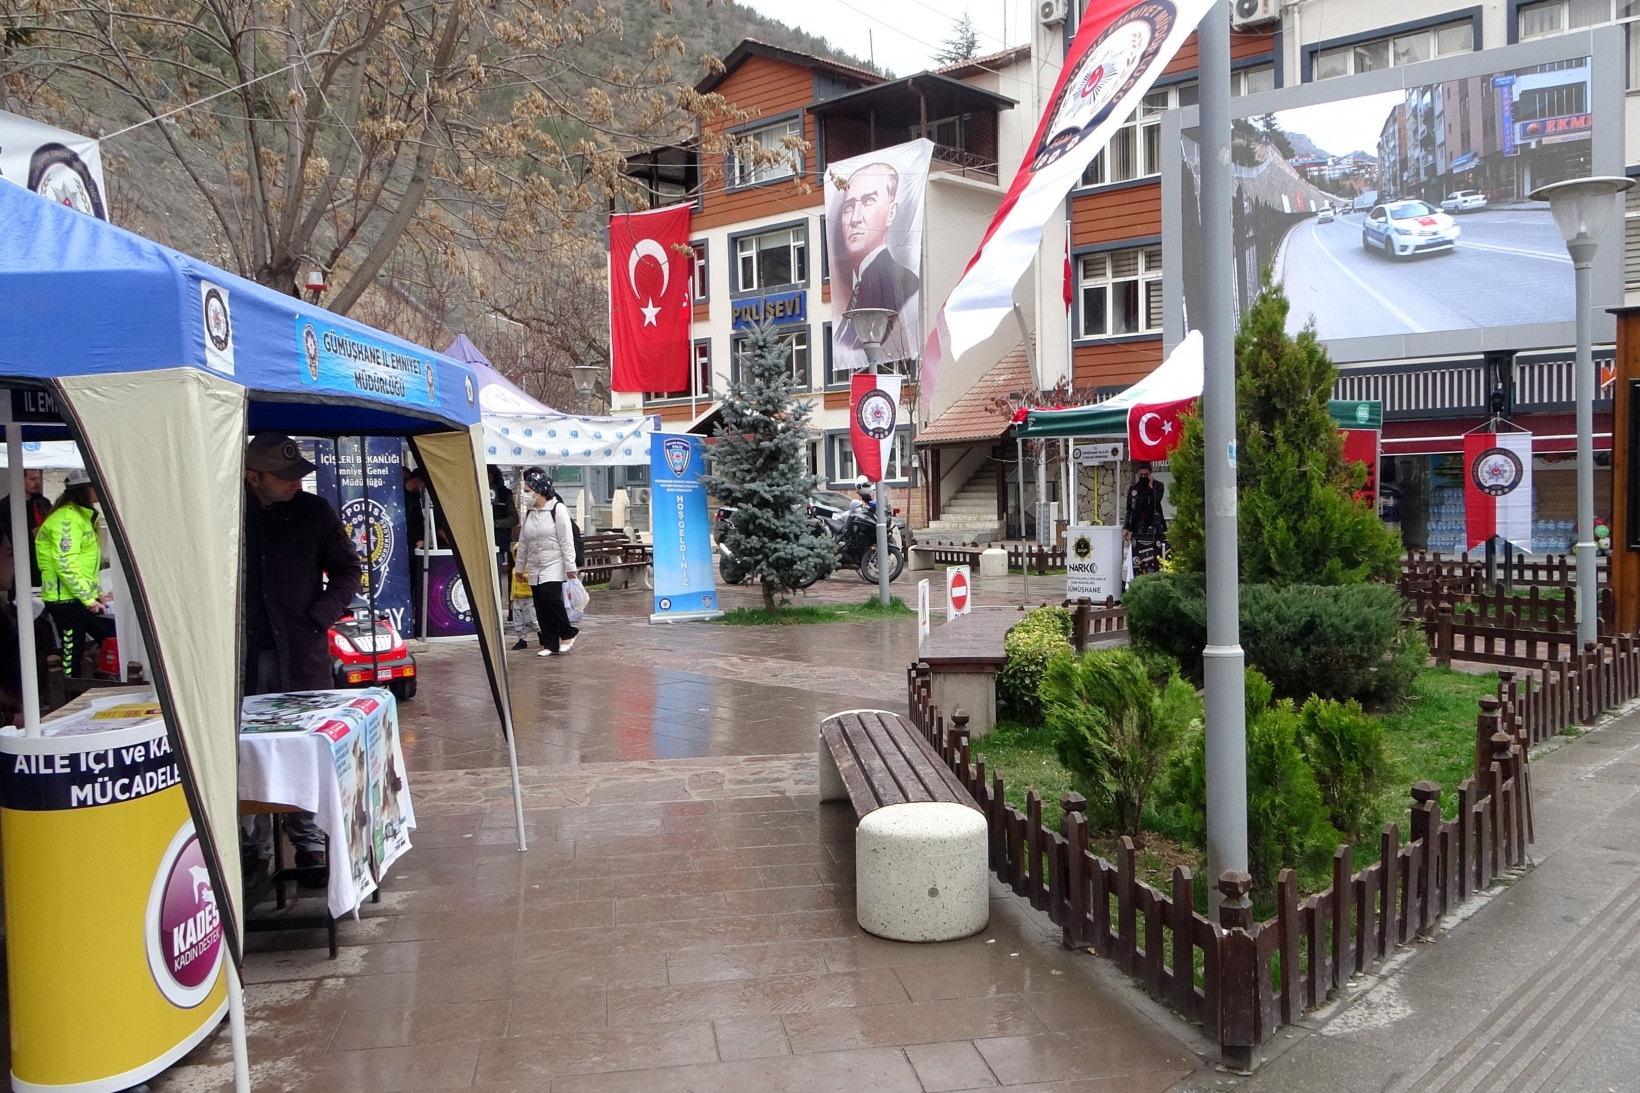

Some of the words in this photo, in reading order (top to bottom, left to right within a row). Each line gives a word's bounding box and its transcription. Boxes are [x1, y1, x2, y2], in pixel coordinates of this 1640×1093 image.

[1107, 4, 1163, 35] EMNİYET
[732, 293, 801, 323] POLSEVİ
[323, 329, 382, 367] GÜMÜŞHANE
[382, 346, 391, 368] İL
[391, 352, 422, 376] EMNİYET
[354, 370, 405, 398] MÜDÜRLÜĞÜ
[356, 453, 400, 464] BKANLIĞI
[367, 467, 389, 475] Genel
[342, 477, 383, 488] Müdülüğü
[121, 745, 145, 765] ve
[173, 903, 220, 957] KADES
[174, 944, 199, 973] KADIN
